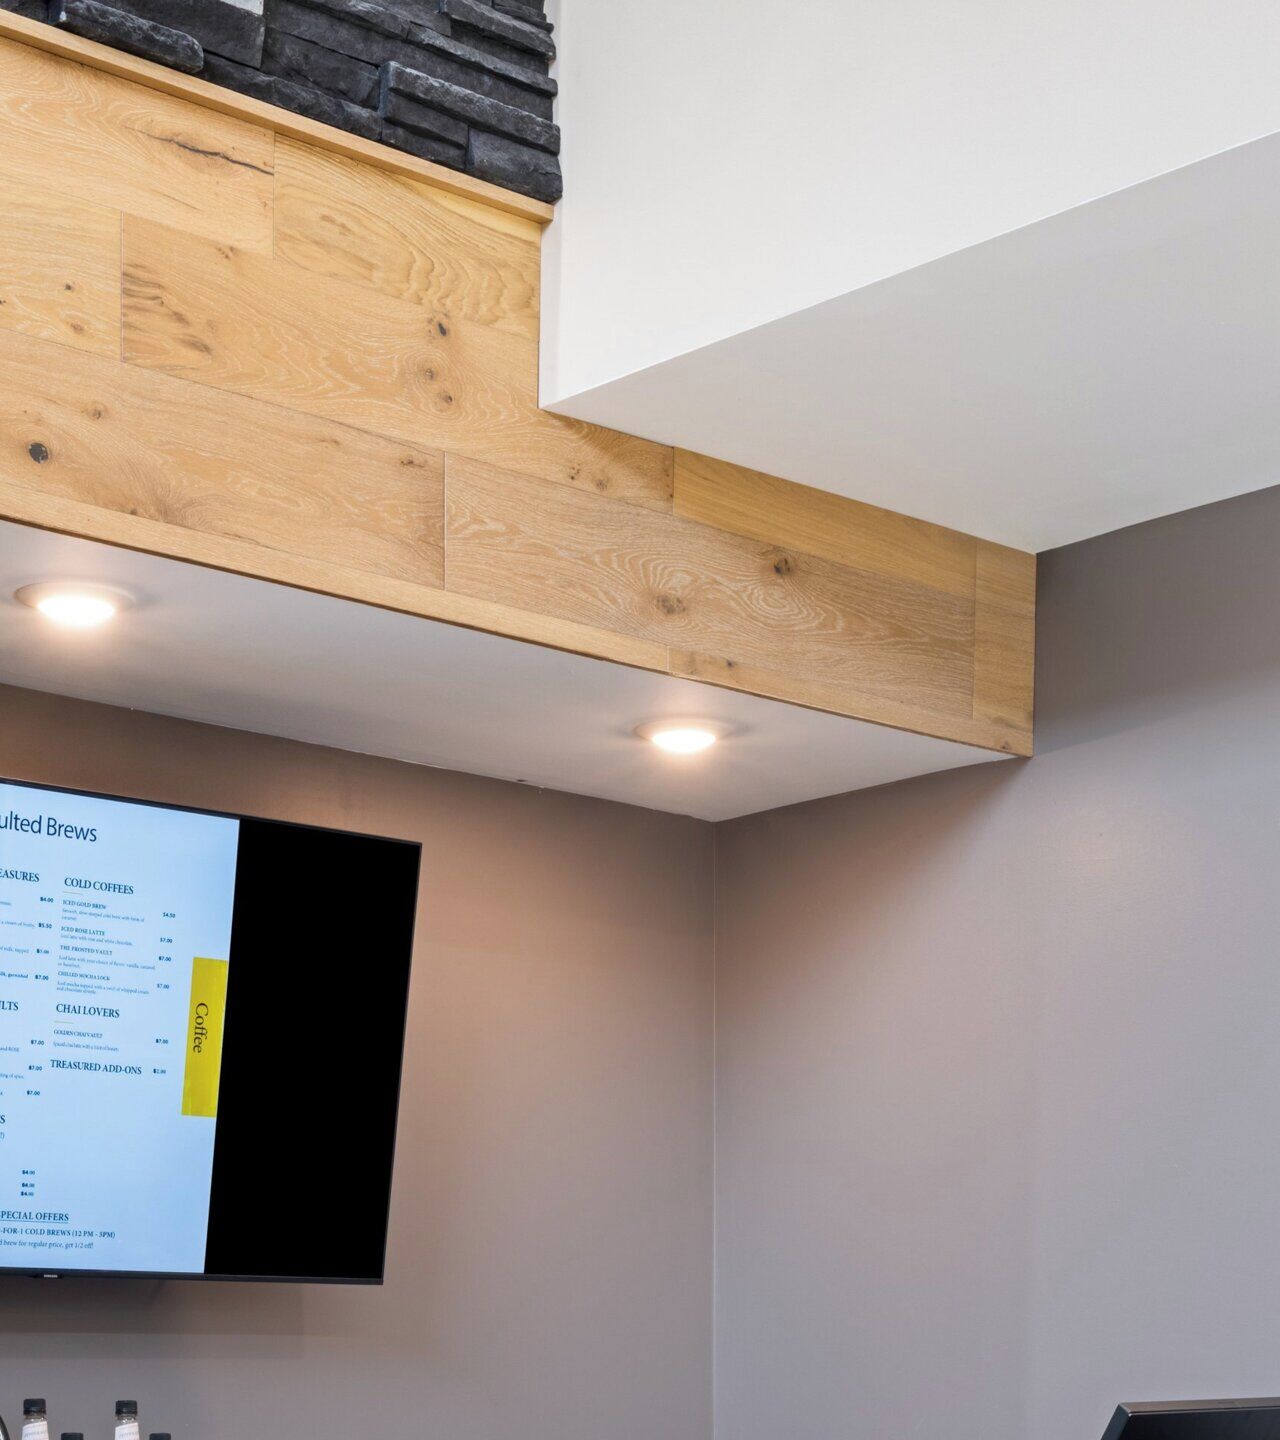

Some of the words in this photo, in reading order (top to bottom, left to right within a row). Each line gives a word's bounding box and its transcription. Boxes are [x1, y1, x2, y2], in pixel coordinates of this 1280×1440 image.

[47, 816, 98, 842] Brews
[64, 877, 92, 889] COLD
[93, 881, 134, 895] COFFEES
[71, 946, 95, 954] FROSTED
[56, 1004, 81, 1015] CHAI
[83, 1006, 120, 1018] LOVERS
[193, 1002, 210, 1054] Coffee
[50, 1059, 101, 1072] TREASURED
[103, 1064, 142, 1075] ADD-ONS
[36, 1212, 70, 1222] OFFERS
[25, 1228, 46, 1236] COLD
[47, 1229, 71, 1237] BREWS
[72, 1230, 82, 1238] (12
